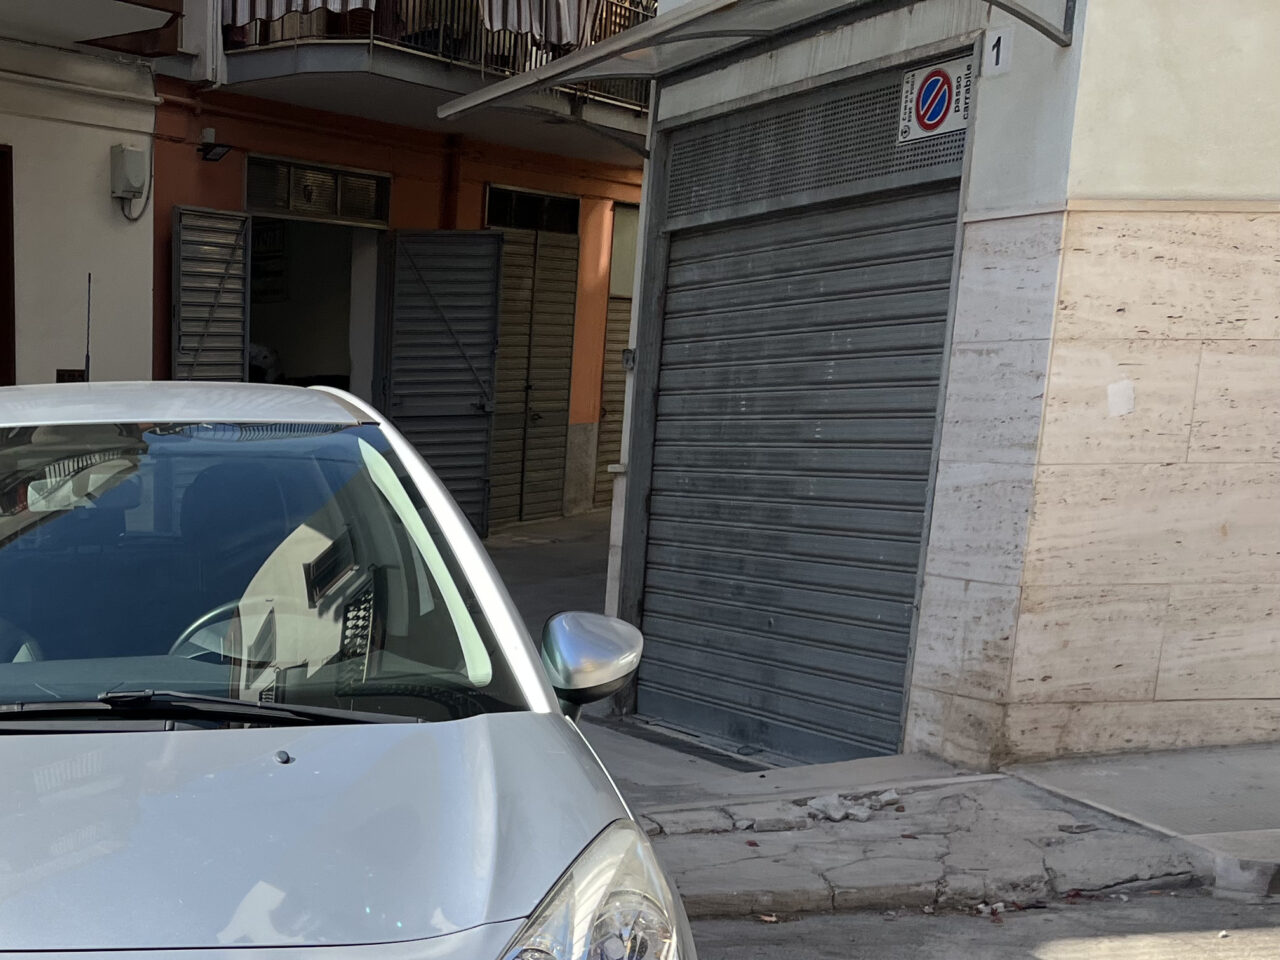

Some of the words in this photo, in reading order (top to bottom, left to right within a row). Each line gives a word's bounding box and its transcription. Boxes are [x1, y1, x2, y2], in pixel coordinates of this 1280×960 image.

[991, 36, 1002, 66] 1
[954, 76, 962, 113] passo
[963, 64, 972, 120] carrabile
